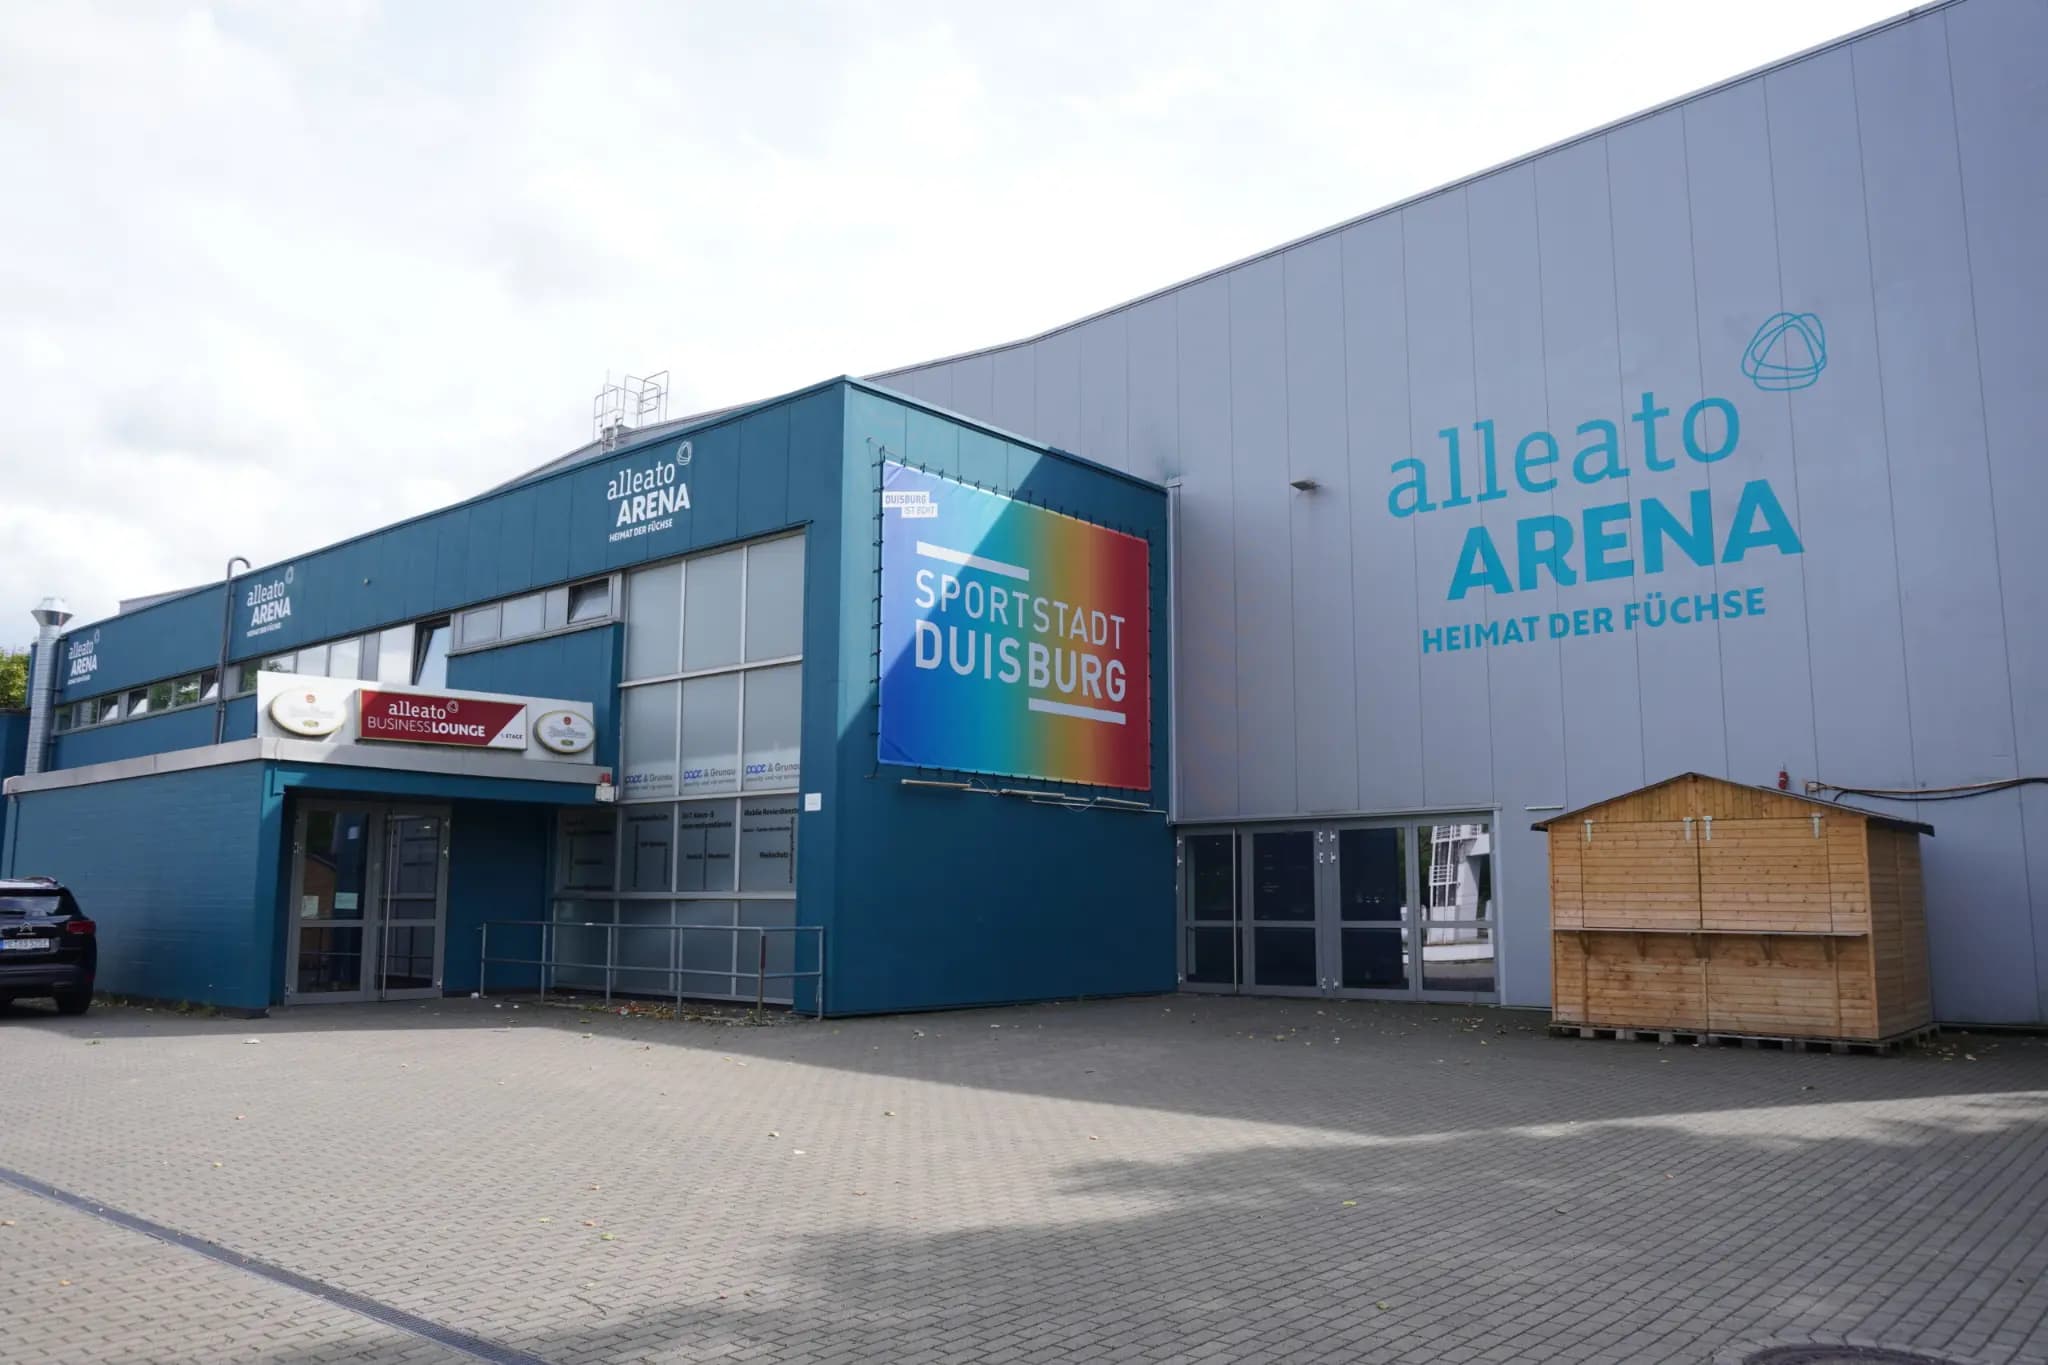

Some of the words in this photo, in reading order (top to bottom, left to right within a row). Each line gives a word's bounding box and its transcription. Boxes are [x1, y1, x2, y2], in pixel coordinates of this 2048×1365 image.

[1388, 392, 1740, 518] alleato
[607, 461, 675, 500] alleato
[885, 494, 928, 505] DUISBURG
[616, 483, 690, 527] ARENA
[609, 529, 632, 543] HEIMAT
[633, 526, 646, 537] DER
[647, 518, 673, 533] FÜCHSE
[1447, 479, 1805, 600] ARENA
[247, 579, 284, 607] alleato
[251, 596, 291, 627] ARENA
[915, 569, 1125, 649] SPORTSTADT
[1423, 616, 1540, 654] HEIMAT
[1549, 607, 1614, 639] DER
[1624, 587, 1766, 631] FÜCHSE
[70, 654, 98, 677] ARENA
[915, 618, 1126, 702] DUISBURG
[388, 701, 446, 720] alleato
